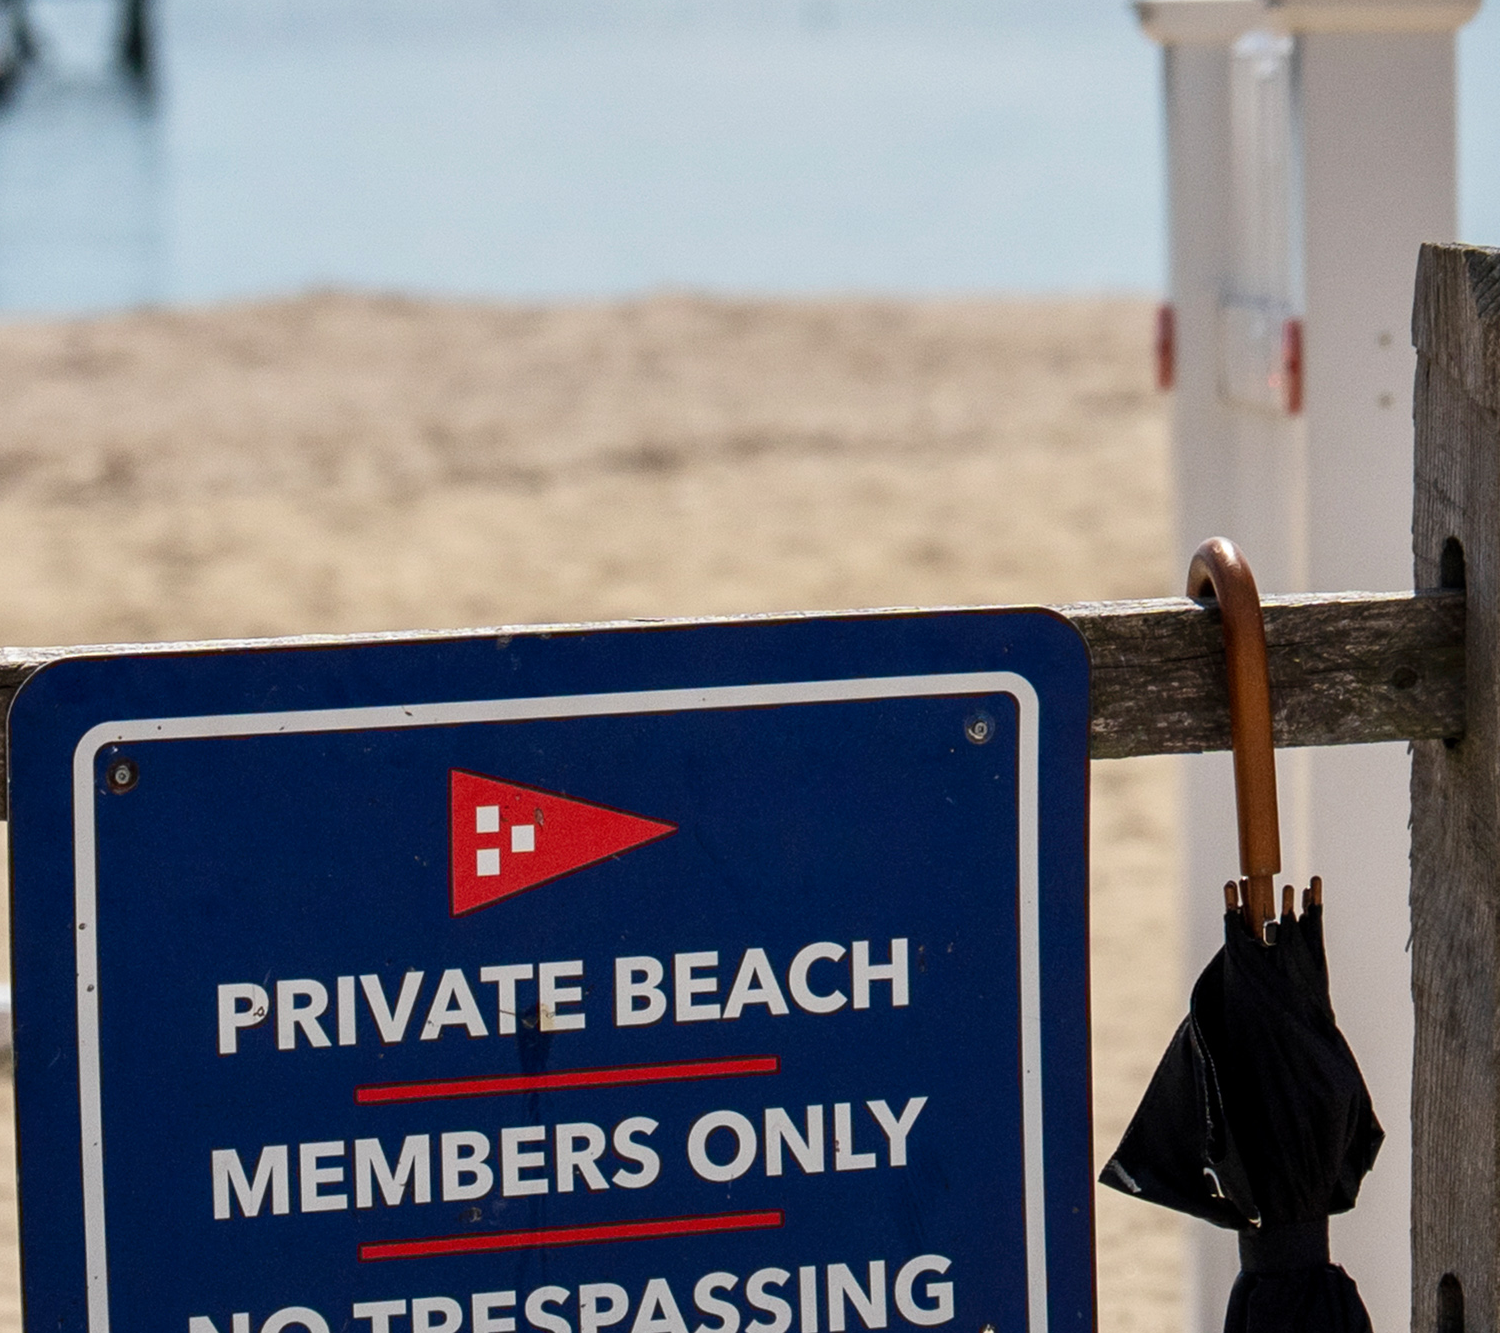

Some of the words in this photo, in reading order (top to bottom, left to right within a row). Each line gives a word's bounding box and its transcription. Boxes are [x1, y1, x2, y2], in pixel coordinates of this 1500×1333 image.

[217, 960, 586, 1054] PRIVATE
[615, 938, 910, 1027] BEACH
[211, 1115, 661, 1220] MEMBERS
[687, 1096, 929, 1182] ONLY
